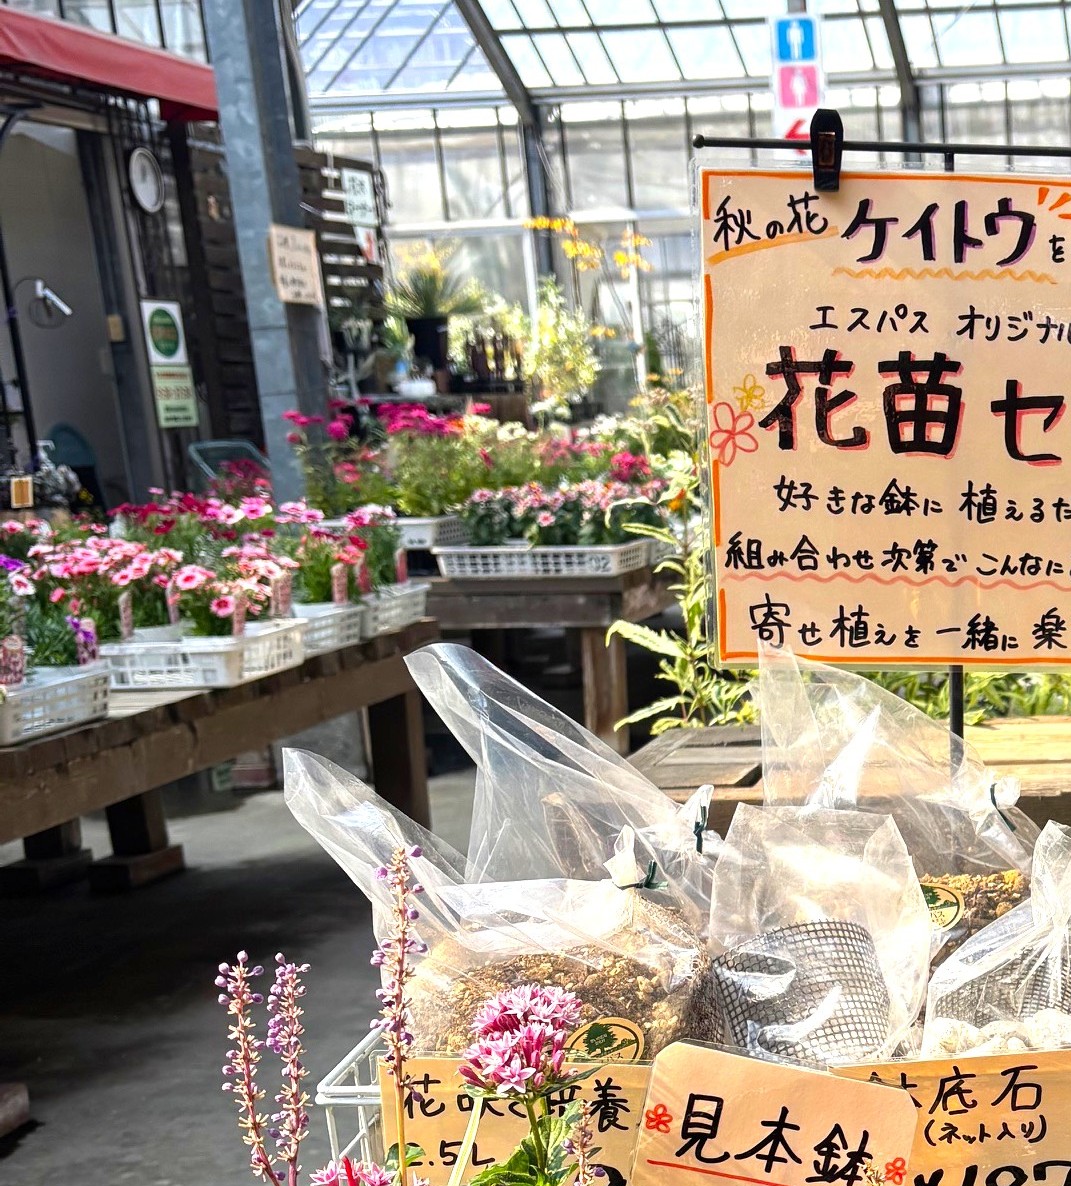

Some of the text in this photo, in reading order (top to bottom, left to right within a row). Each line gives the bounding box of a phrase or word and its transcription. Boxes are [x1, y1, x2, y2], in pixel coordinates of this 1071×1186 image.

[713, 191, 829, 251] 秋の花
[841, 198, 1037, 267] ケイトウ
[809, 303, 929, 333] エスパス
[773, 475, 943, 517] 好きな鉢に
[724, 531, 968, 575] 組み合わせ次第で
[750, 593, 921, 648] 寄せ植えを
[936, 613, 1019, 652] 一緒に
[872, 1065, 1042, 1115] 底石
